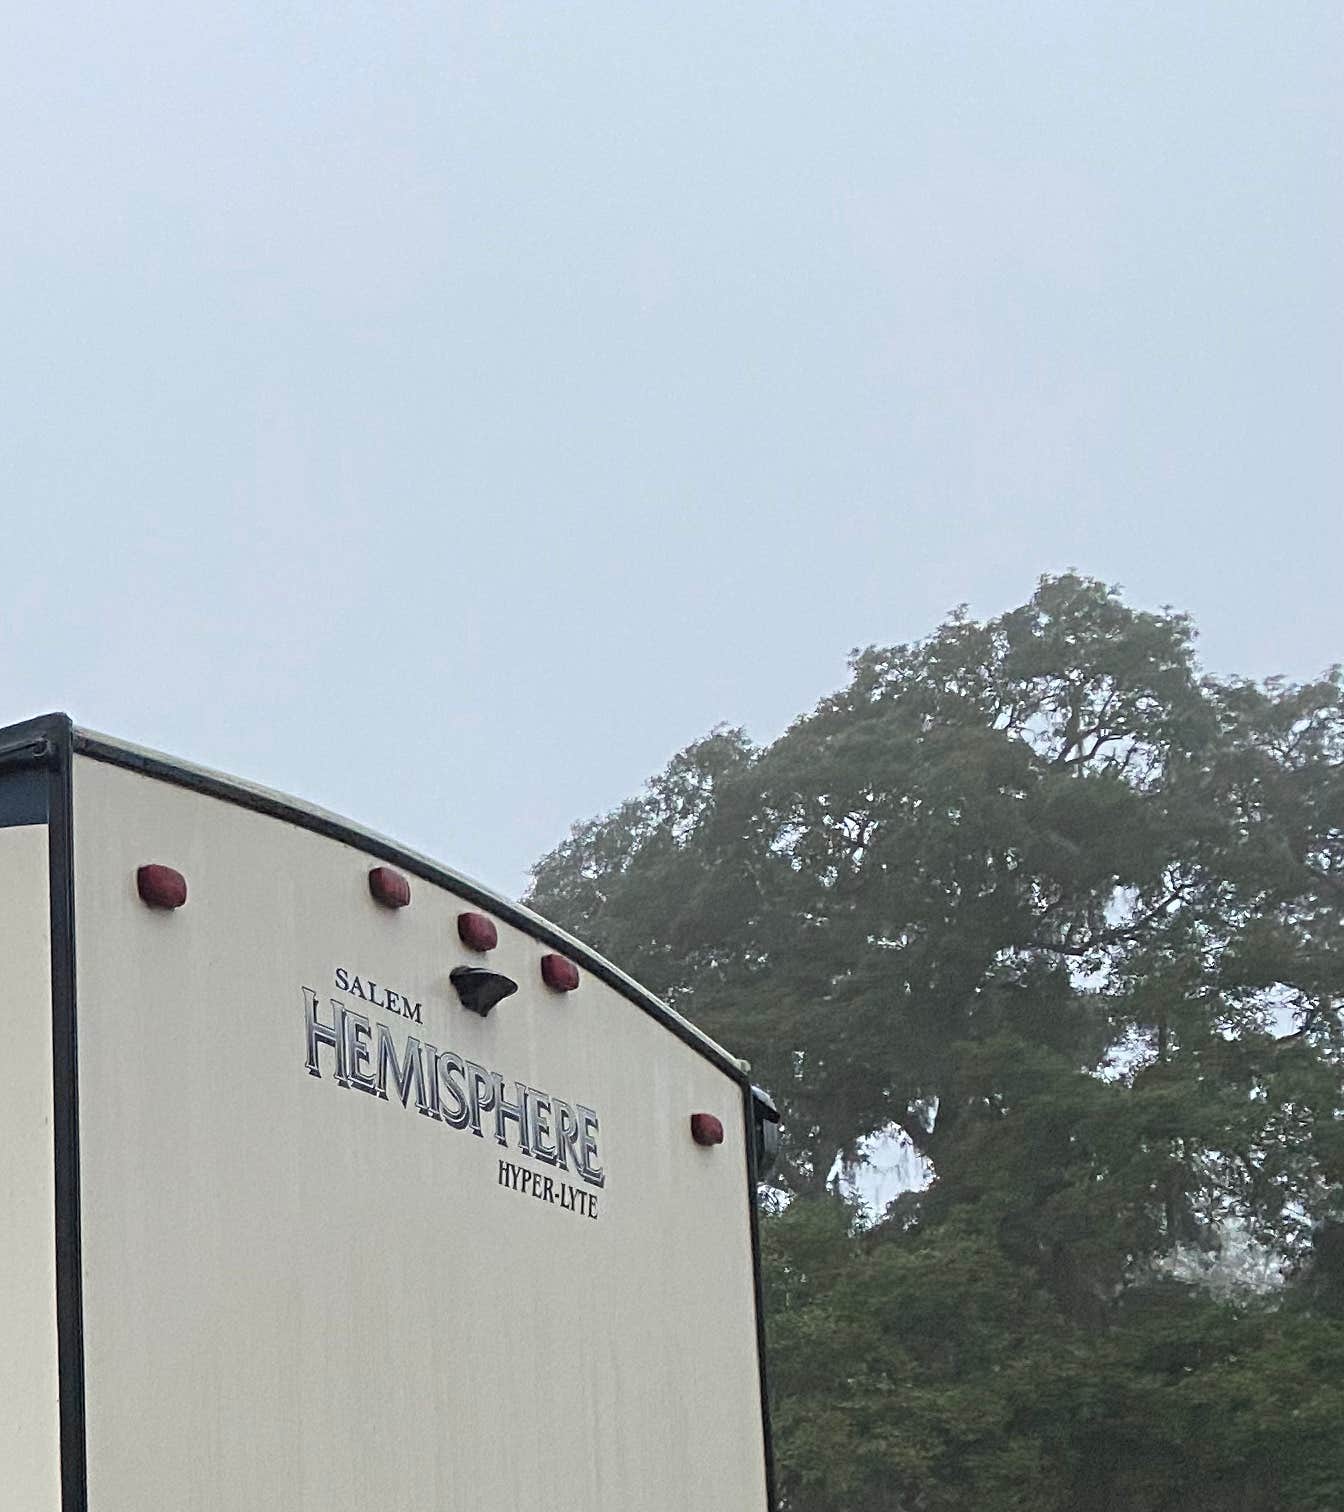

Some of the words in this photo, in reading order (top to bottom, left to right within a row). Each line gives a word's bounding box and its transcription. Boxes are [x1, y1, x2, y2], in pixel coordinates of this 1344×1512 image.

[335, 967, 424, 1025] SALEM
[301, 986, 607, 1188] HEMISPHERE
[498, 1159, 599, 1220] HYPER-LYTE
